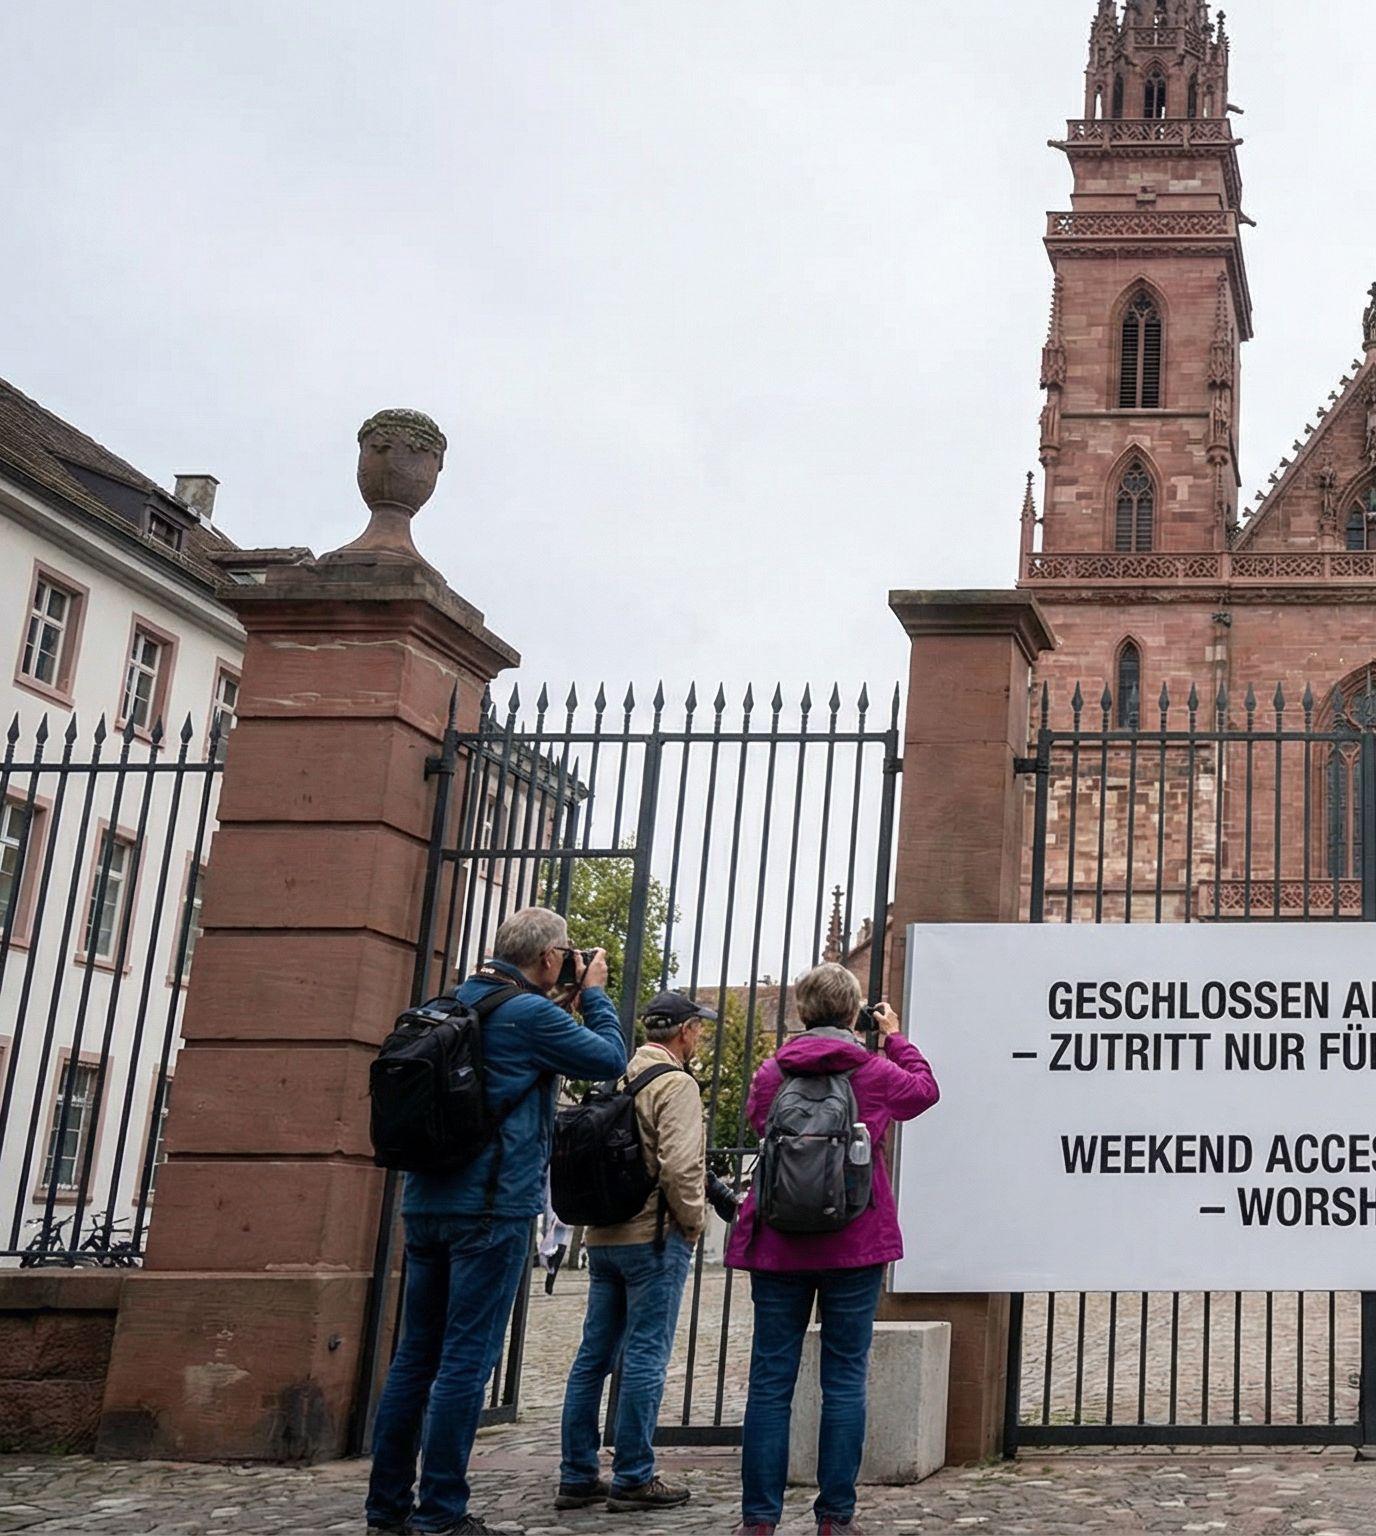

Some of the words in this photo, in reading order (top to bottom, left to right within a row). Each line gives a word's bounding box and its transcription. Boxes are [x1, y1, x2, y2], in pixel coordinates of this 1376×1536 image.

[1049, 981, 1328, 1019] GESCHLOSSEN
[1049, 1033, 1211, 1071] ZUTRITT
[1225, 1033, 1305, 1071] NUR
[1061, 1135, 1252, 1173] WEEKEND
